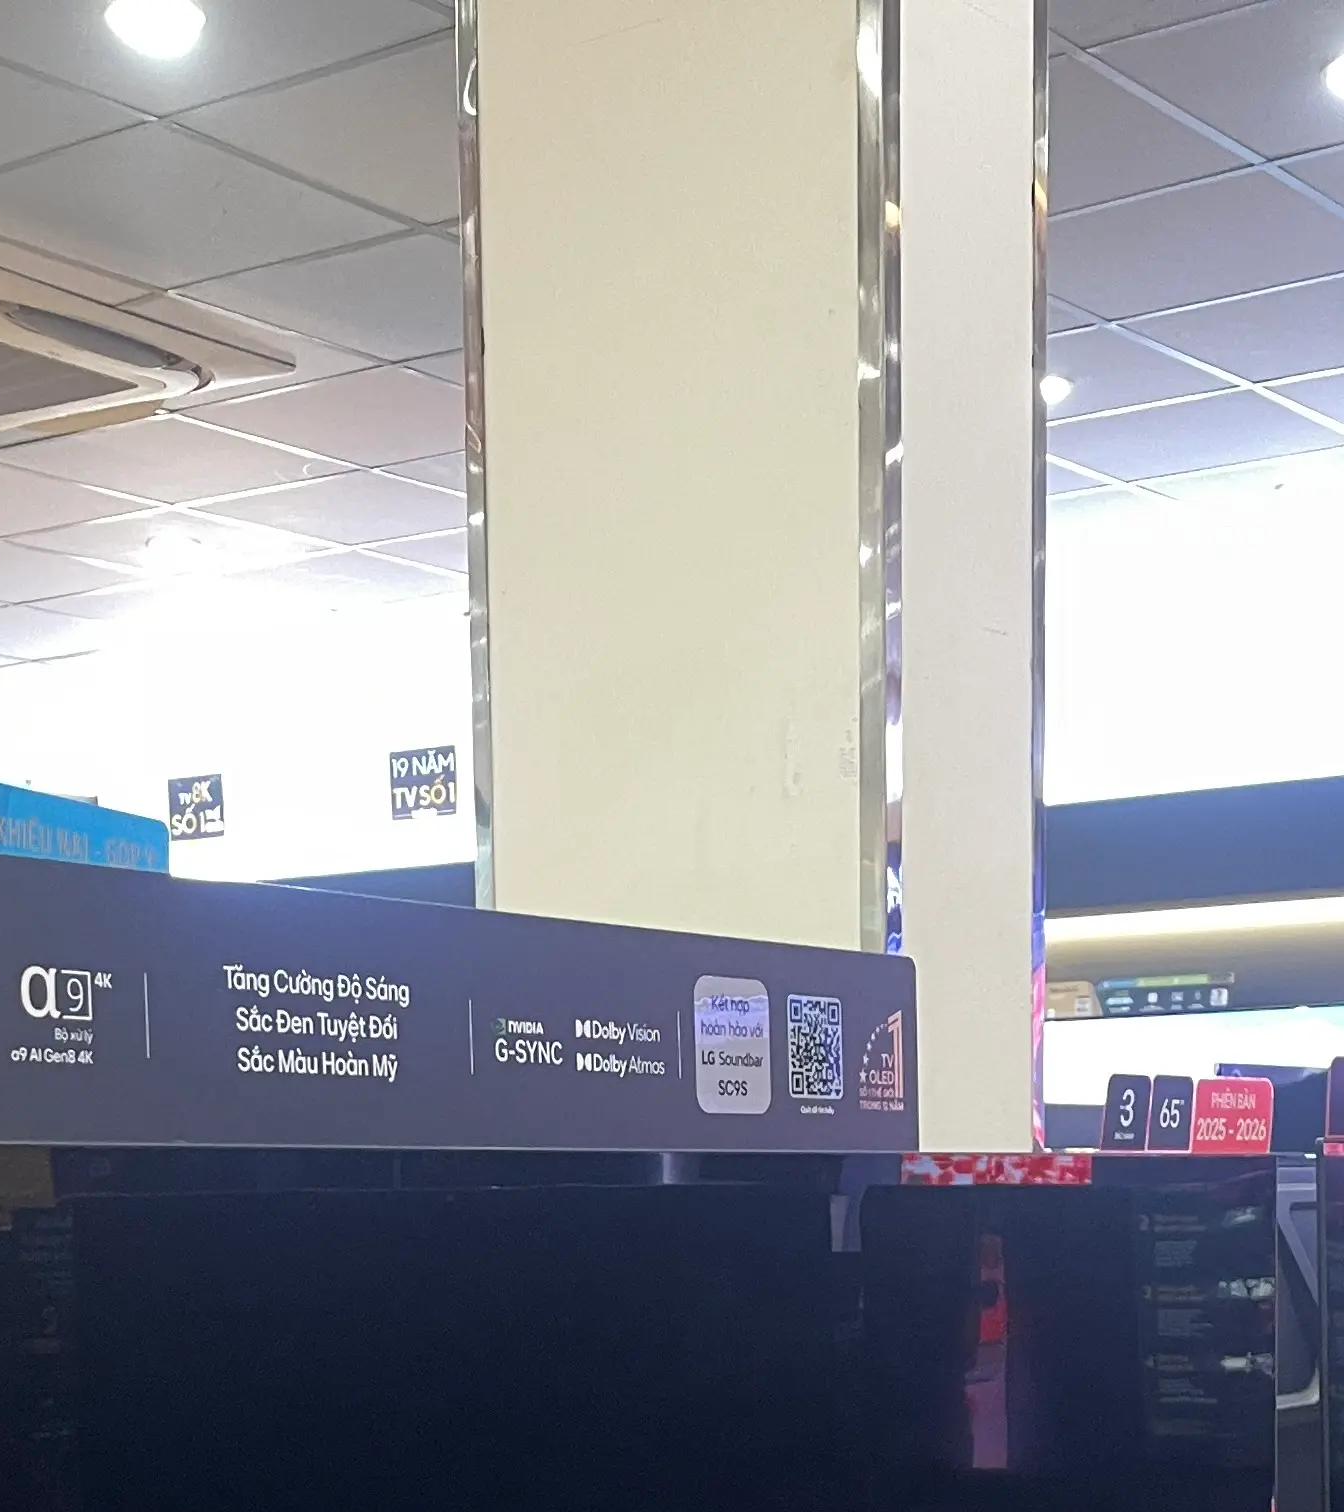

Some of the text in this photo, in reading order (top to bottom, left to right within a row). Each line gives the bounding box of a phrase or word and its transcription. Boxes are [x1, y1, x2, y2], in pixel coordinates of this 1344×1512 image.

[392, 750, 455, 778] 19 NĂM
[393, 787, 418, 809] TV
[419, 774, 446, 805] SỐ
[171, 805, 197, 836] SỐ
[93, 972, 113, 990] 4K
[222, 963, 410, 1008] Tăng Cường Độ Sáng
[710, 993, 750, 1016] Kết hợp
[54, 1026, 68, 1043] Bộ
[236, 1004, 398, 1043] Sắc Đen Tuyệt Đối
[592, 1019, 661, 1045] Dolby Vision
[700, 1018, 727, 1036] hoàn
[728, 1020, 748, 1038] hảo
[29, 1048, 43, 1062] AI
[43, 1048, 76, 1064] Gen8
[77, 1049, 94, 1065] 4K
[495, 1037, 563, 1065] G-SYNC
[702, 1050, 764, 1067] LG Soundbar
[881, 1053, 894, 1068] TV
[237, 1045, 398, 1083] Sắc Màu Hoàn Mỹ
[593, 1053, 666, 1078] Dolby Atmos
[718, 1080, 748, 1096] SC9S
[869, 1069, 895, 1085] OLED
[1119, 1088, 1136, 1127] 3
[1196, 1118, 1227, 1141] 2025
[1235, 1118, 1267, 1141] 2026
